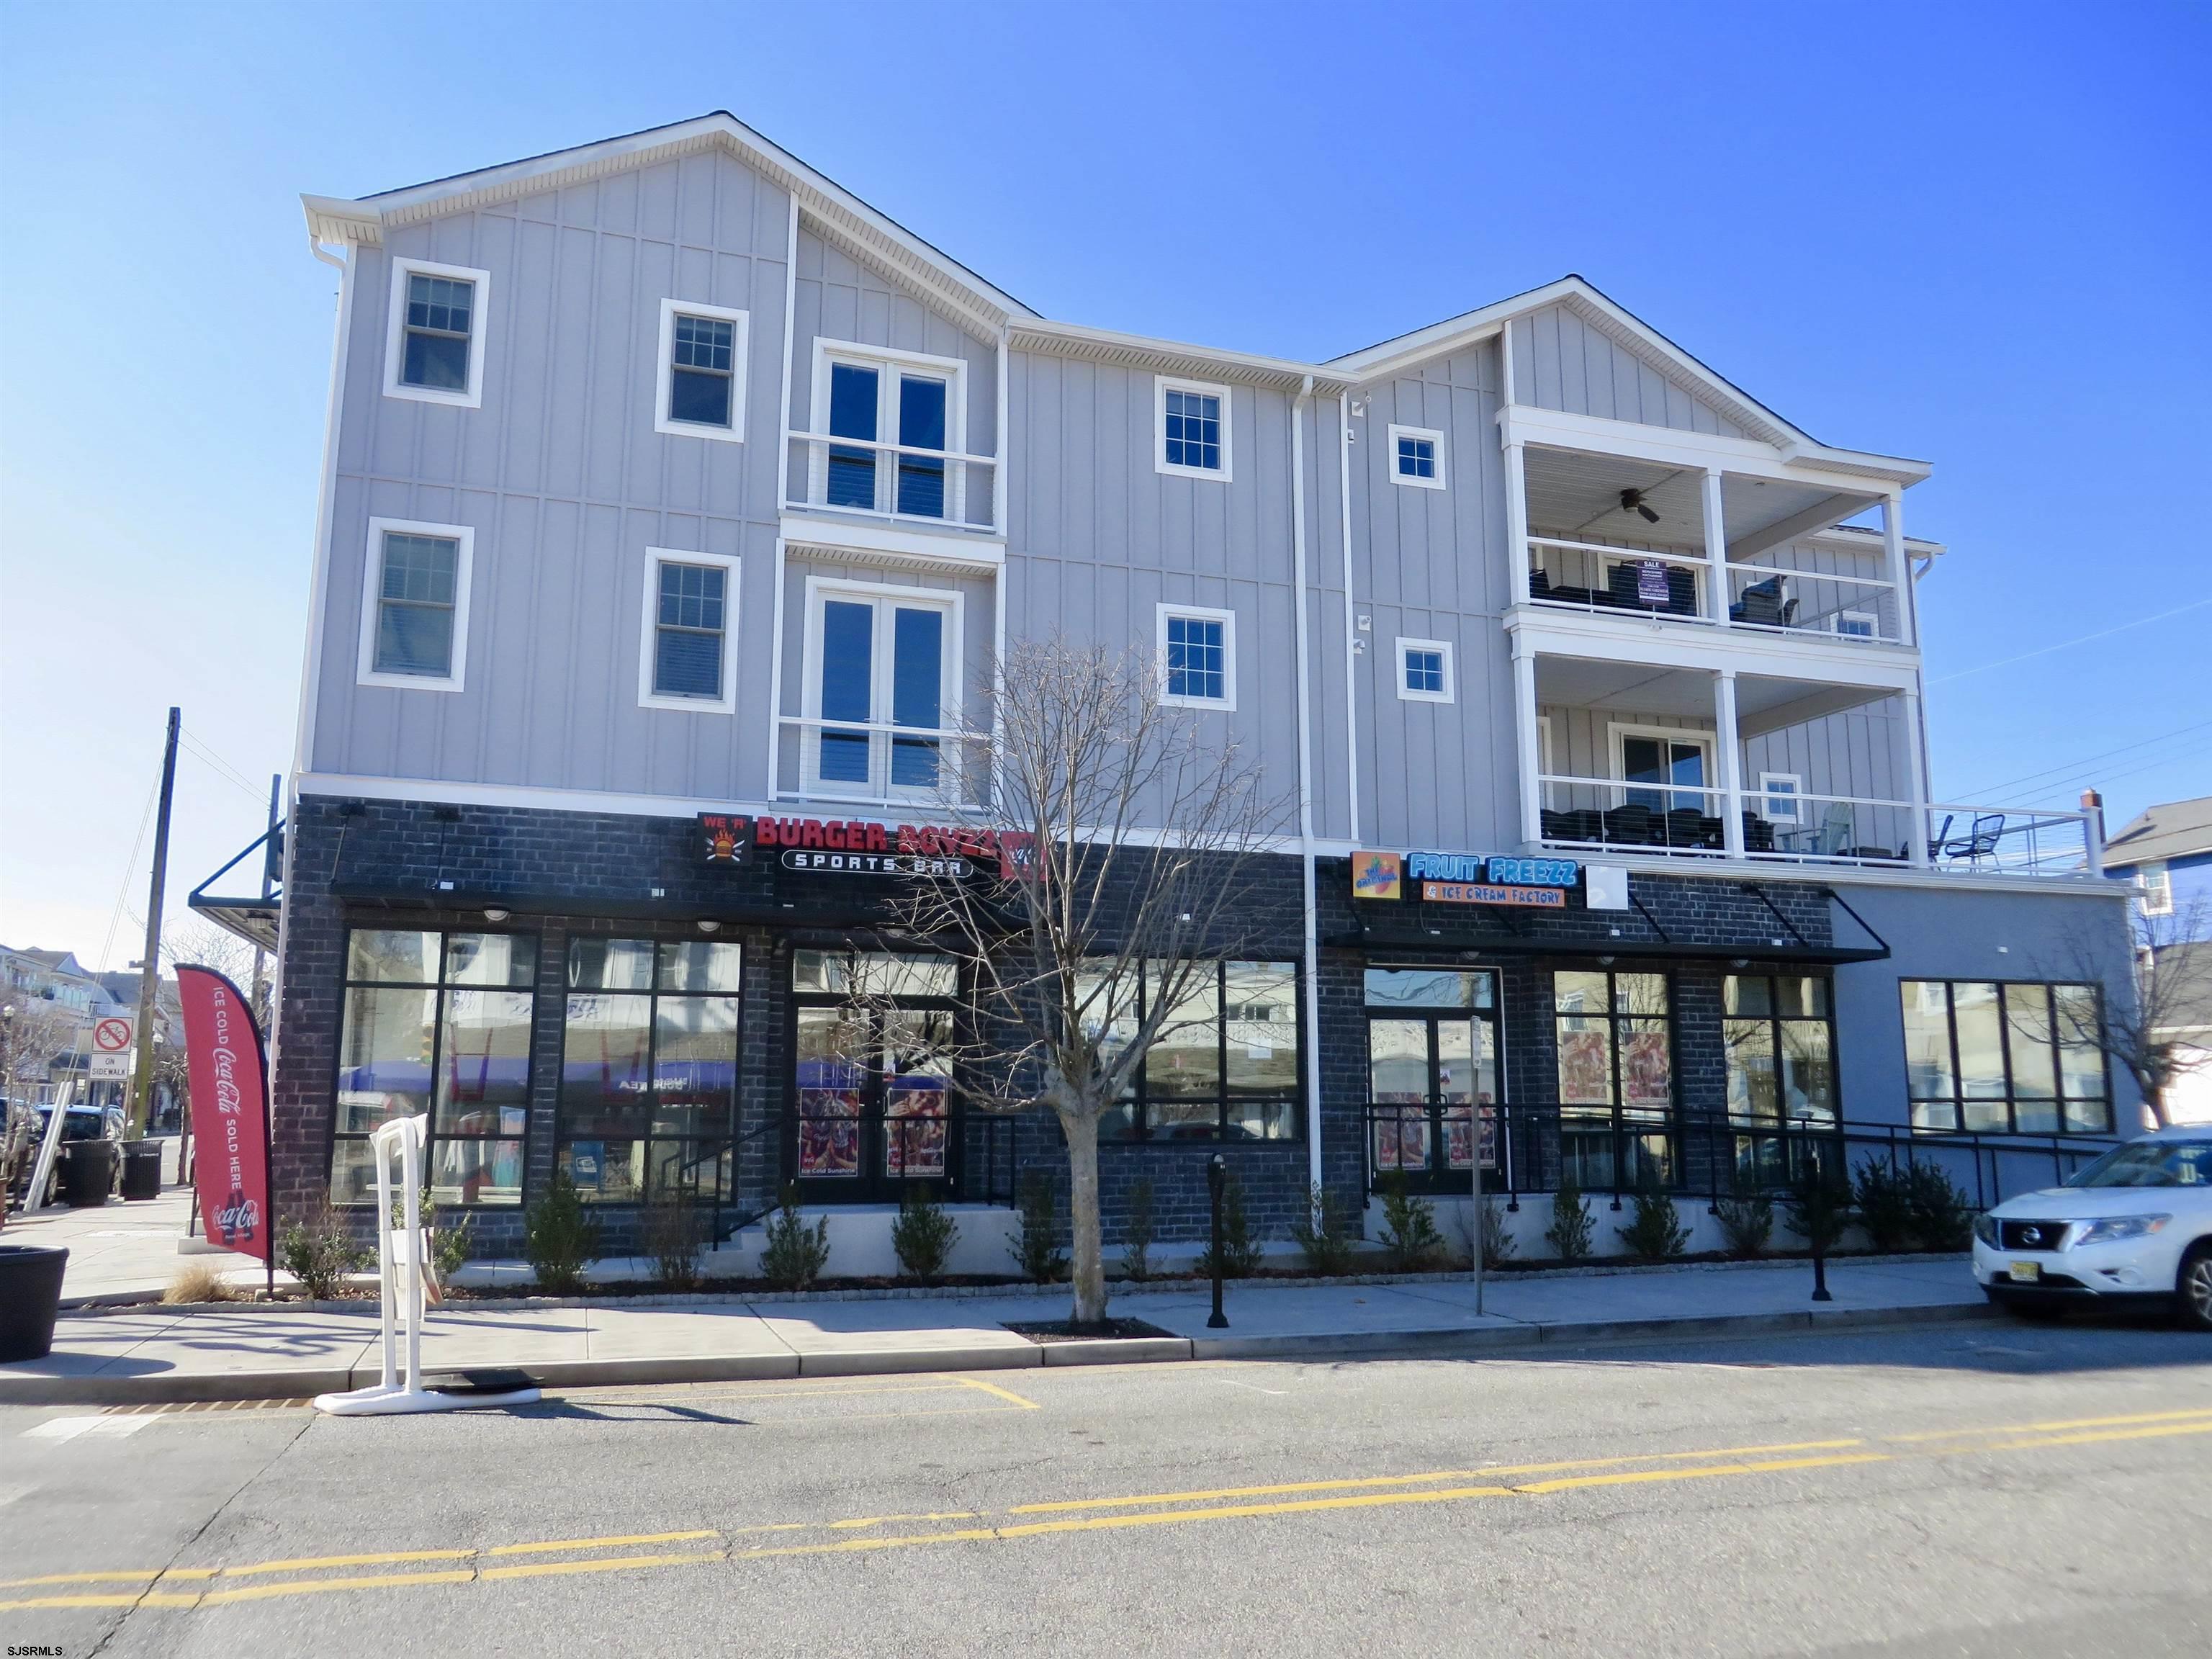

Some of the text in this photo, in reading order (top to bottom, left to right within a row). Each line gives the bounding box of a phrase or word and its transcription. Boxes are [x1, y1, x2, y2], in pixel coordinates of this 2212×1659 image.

[703, 816, 727, 828] WE
[757, 816, 888, 850] BURGER
[795, 854, 961, 874] SPORTS BAR
[1409, 853, 1577, 886] FRUIT FREEZZ
[1442, 886, 1461, 899] ICE
[1466, 887, 1506, 901] CREAM
[1511, 889, 1560, 904] FACTORY
[213, 986, 225, 1007] ICE
[217, 1010, 229, 1045] COLD
[226, 1119, 238, 1153] SOLD
[230, 1156, 242, 1190] HERE
